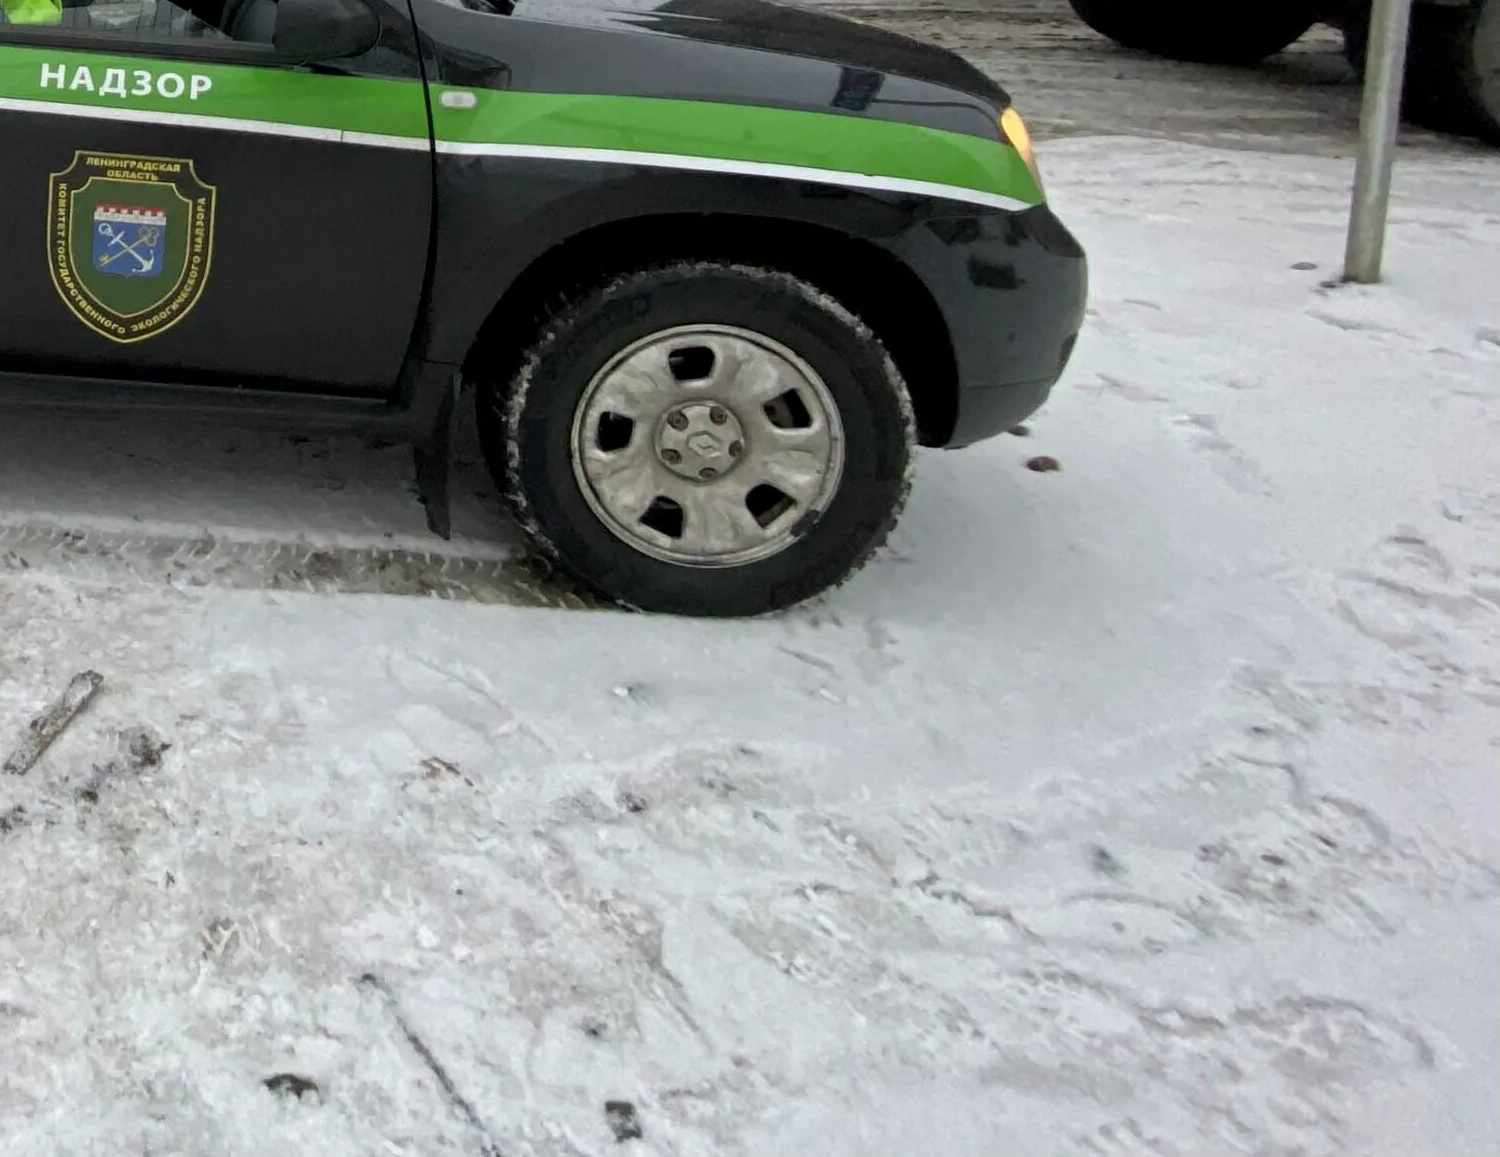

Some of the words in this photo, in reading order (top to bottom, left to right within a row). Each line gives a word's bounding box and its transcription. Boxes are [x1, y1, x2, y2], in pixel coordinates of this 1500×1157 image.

[40, 62, 213, 100] НАДЗОР
[85, 157, 181, 173] ЛЕНИНГРАДСКАЯ
[106, 170, 158, 181] ОБЛАСТЬ
[56, 183, 68, 237] КОМИТЕТ
[193, 197, 206, 253] НАДЗОРА
[56, 240, 126, 334] ГОСУДАРСТВЕННОГО
[130, 255, 201, 332] ЭКОЛОГИЧЕСКОГО
